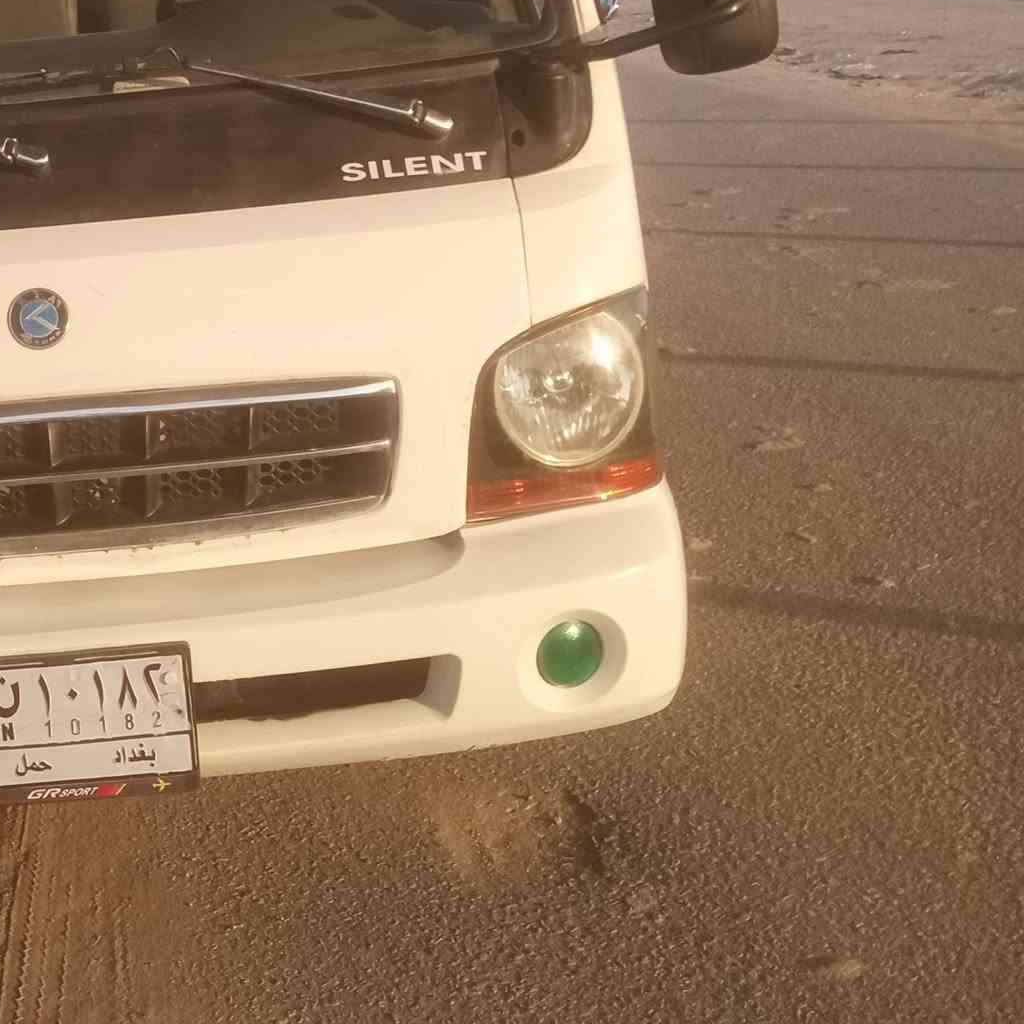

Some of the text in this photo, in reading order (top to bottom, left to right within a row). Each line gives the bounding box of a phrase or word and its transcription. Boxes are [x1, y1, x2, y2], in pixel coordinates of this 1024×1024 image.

[340, 150, 488, 183] SILENT
[15, 742, 157, 777] بغداد حمل
